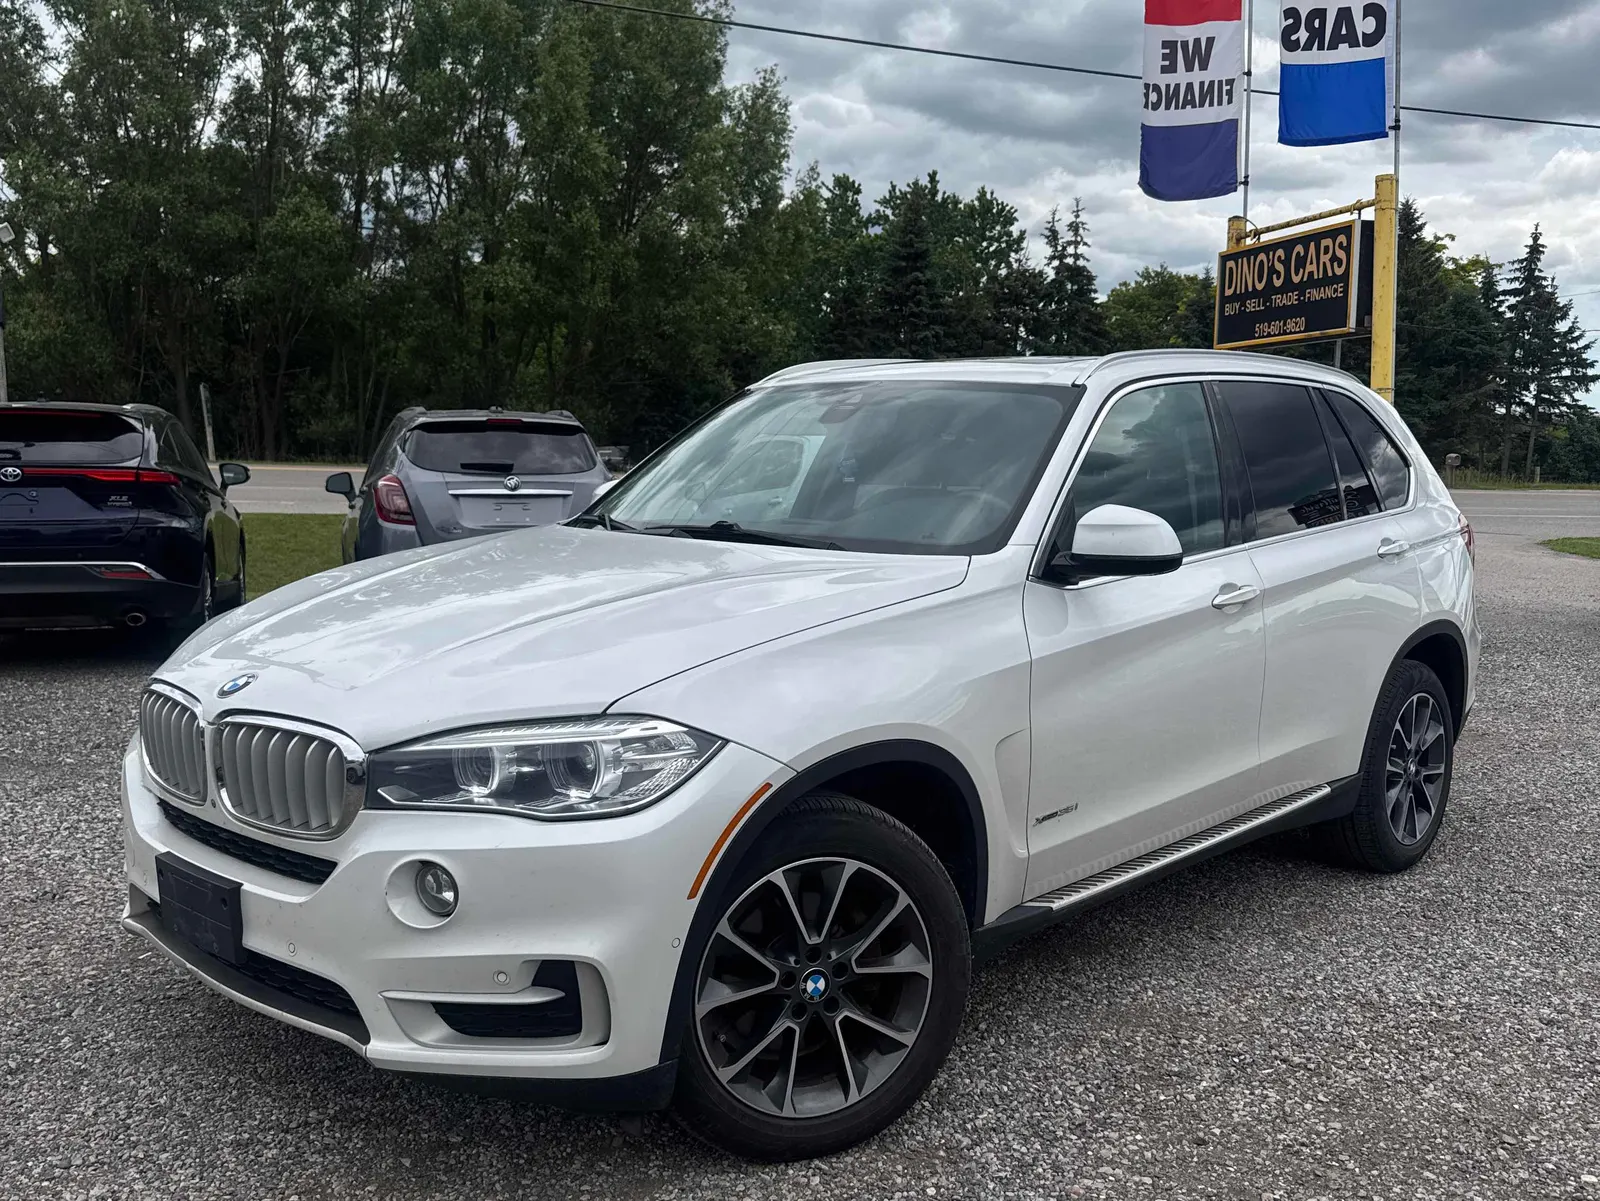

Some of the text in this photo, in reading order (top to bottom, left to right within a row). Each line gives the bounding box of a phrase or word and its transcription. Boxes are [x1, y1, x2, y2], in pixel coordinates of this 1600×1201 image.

[1224, 234, 1347, 296] DINO'S CARS
[1224, 302, 1240, 316] BUY
[1245, 299, 1265, 312] SELL
[1271, 291, 1299, 308] TRADE
[1305, 283, 1344, 302] FINANCE
[1255, 317, 1306, 337] 519-601-9620
